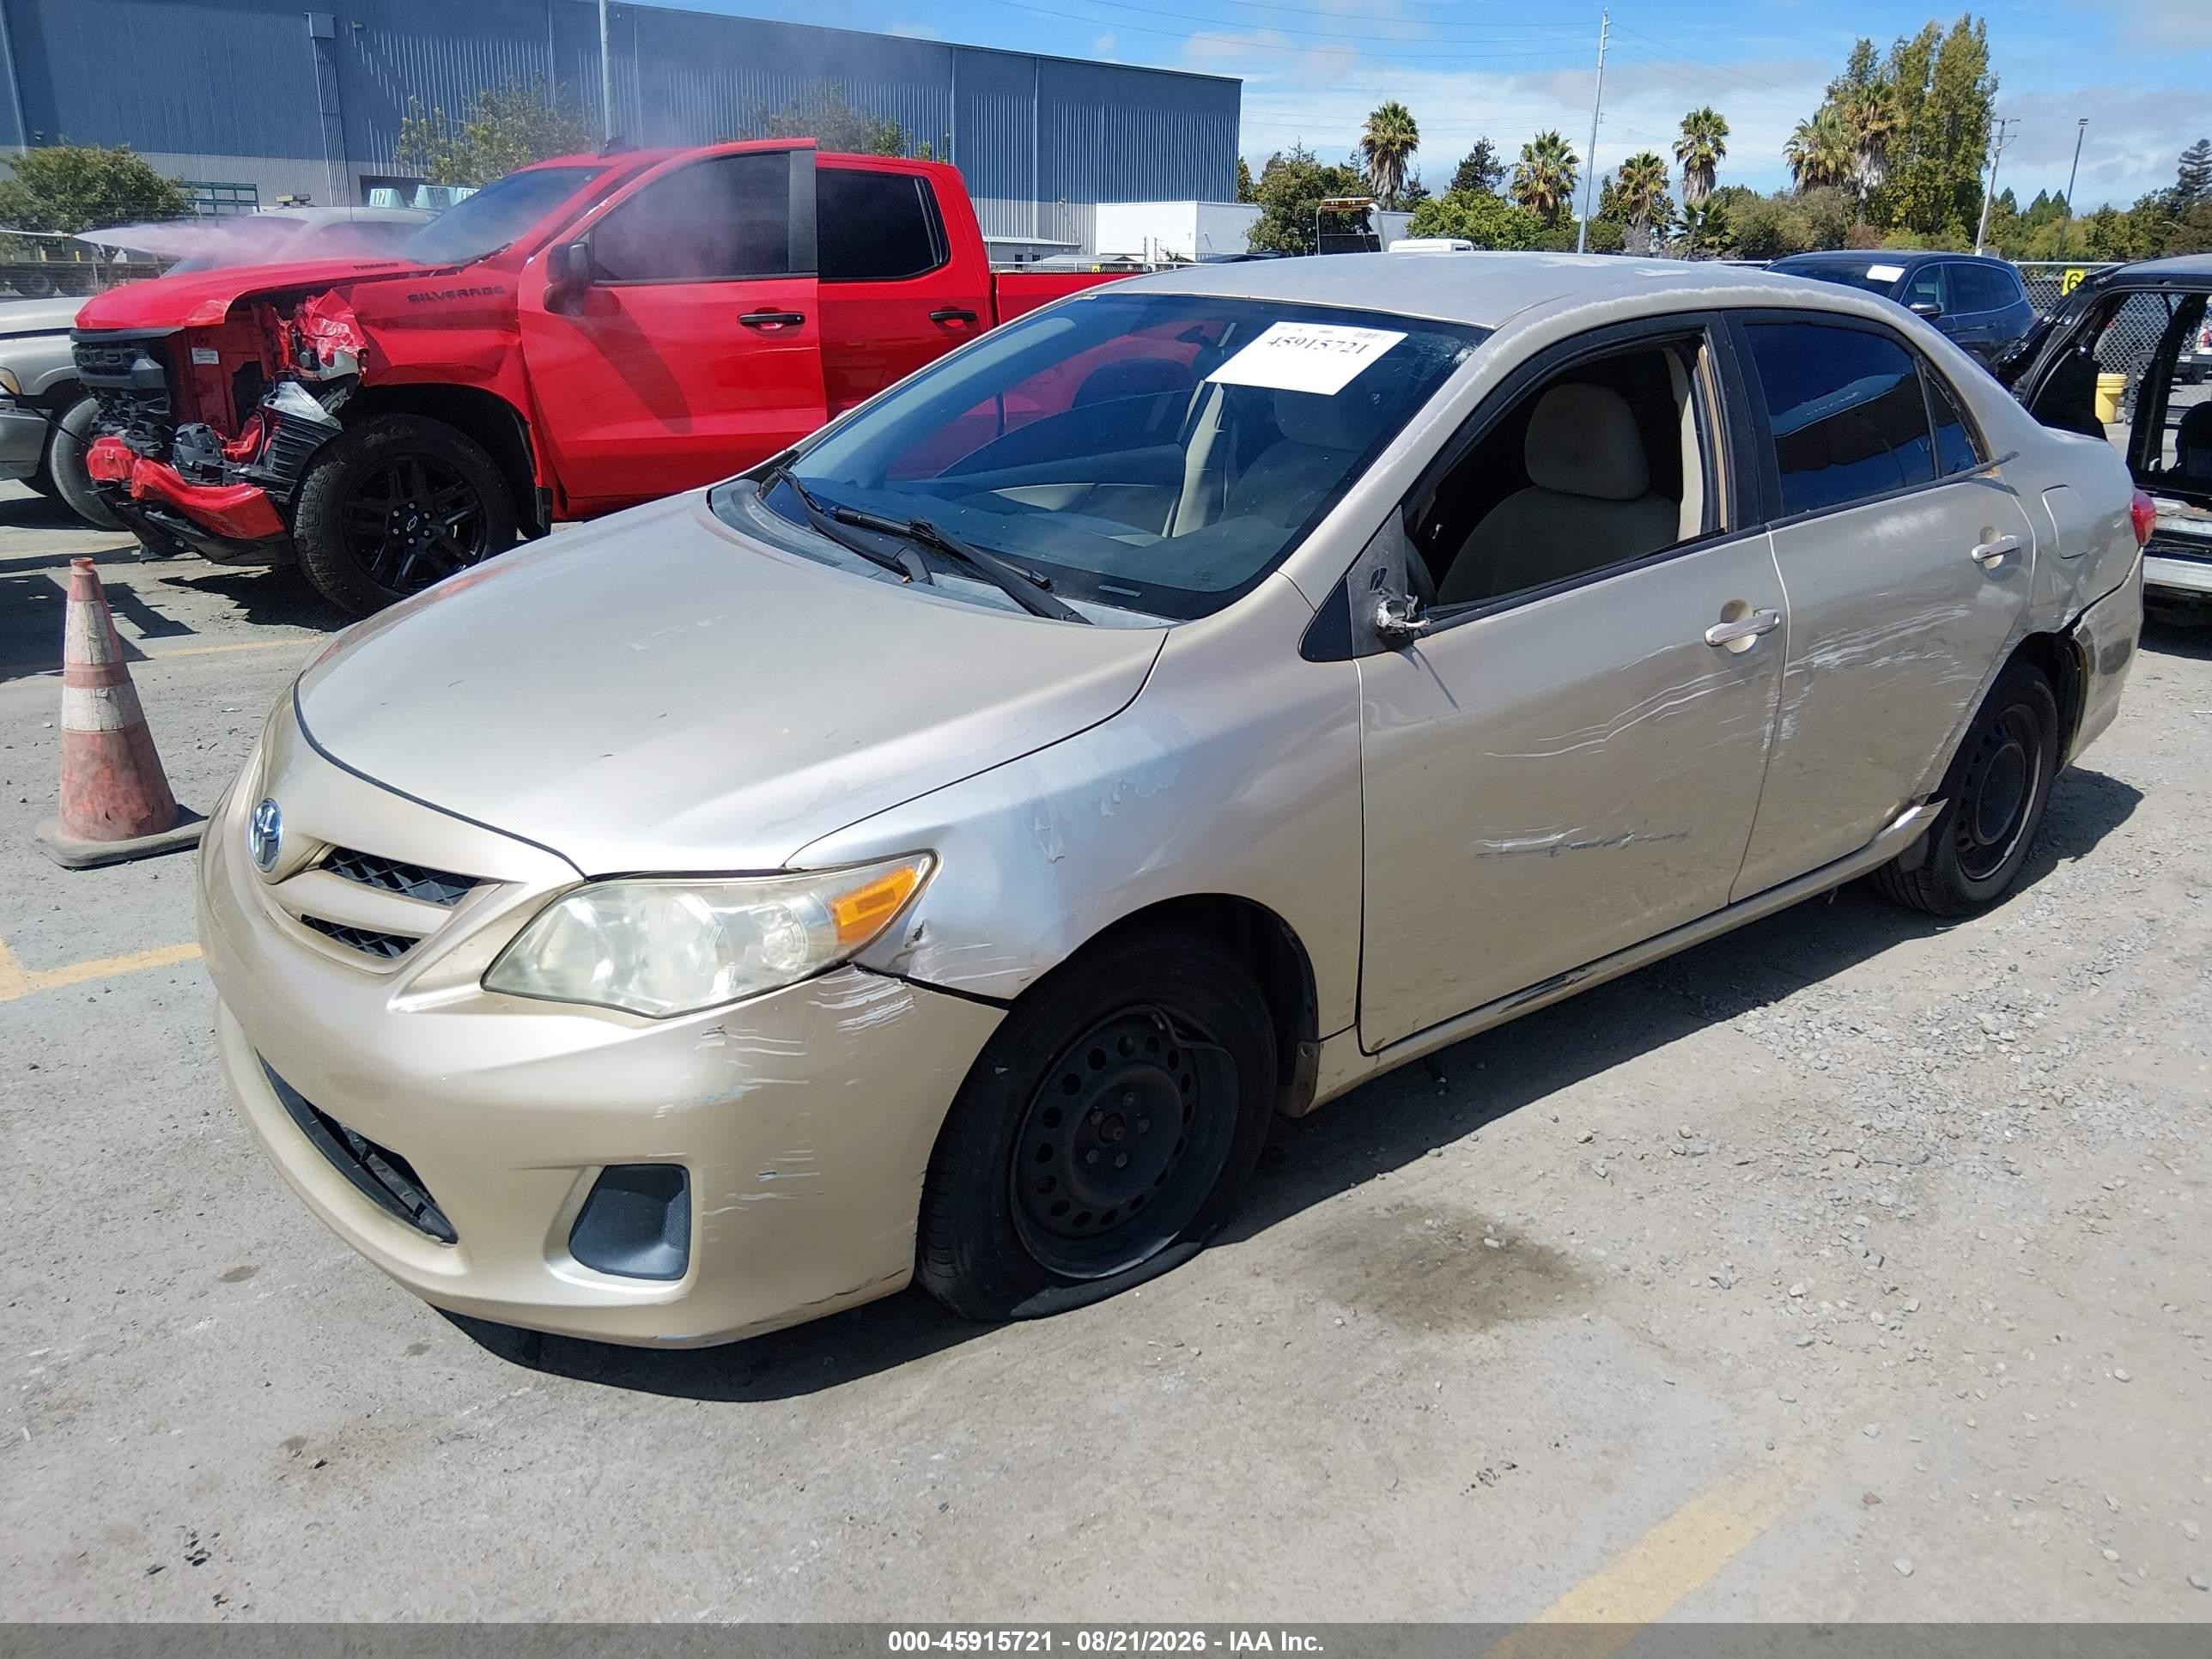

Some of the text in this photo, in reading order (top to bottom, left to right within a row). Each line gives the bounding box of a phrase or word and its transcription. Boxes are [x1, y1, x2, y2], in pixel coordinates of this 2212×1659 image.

[374, 189, 386, 204] 17
[408, 286, 505, 302] SILVERADO
[1267, 336, 1370, 355] 45915721
